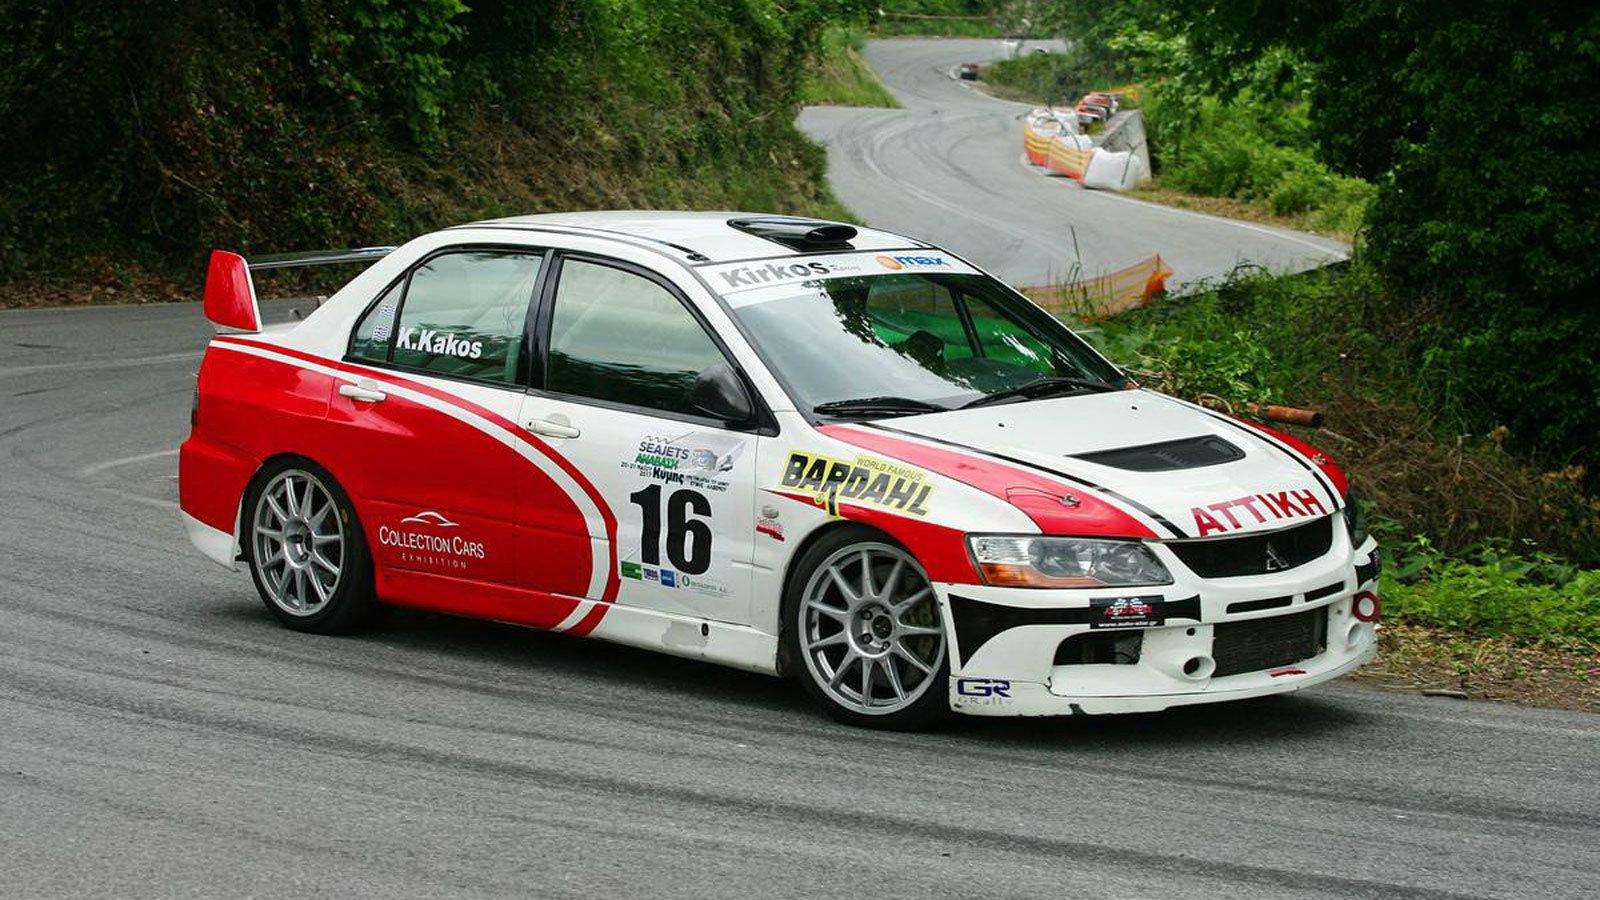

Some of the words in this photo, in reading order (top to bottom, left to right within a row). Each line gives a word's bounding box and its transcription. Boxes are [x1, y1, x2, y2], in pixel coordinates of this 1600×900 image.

[719, 262, 830, 288] Kirkos
[397, 327, 483, 359] K.Kakos
[639, 441, 689, 460] SEAJETS
[857, 458, 887, 472] WORLD
[888, 465, 923, 482] FAMOUS
[781, 453, 932, 516] BARDAHL
[379, 526, 451, 553] COLLECTION
[453, 536, 485, 559] CARS
[630, 483, 713, 576] 16
[402, 553, 467, 569] EXHIBITION
[957, 679, 1012, 698] GR
